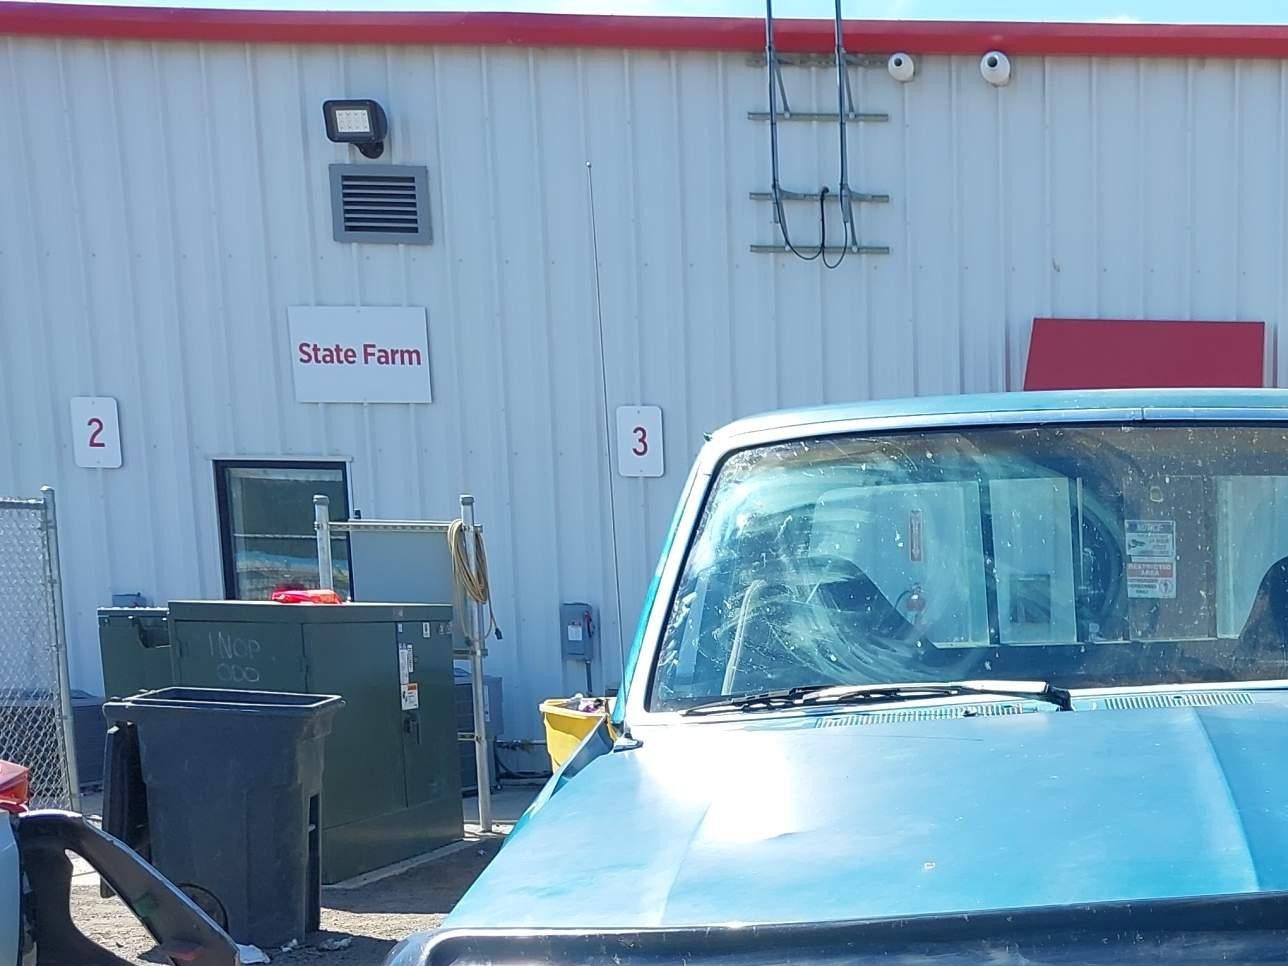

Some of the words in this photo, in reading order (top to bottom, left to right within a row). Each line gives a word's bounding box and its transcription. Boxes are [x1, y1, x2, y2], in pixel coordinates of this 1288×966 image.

[298, 342, 357, 364] State
[362, 343, 422, 366] Farm
[87, 417, 105, 448] 2
[632, 426, 648, 457] 3
